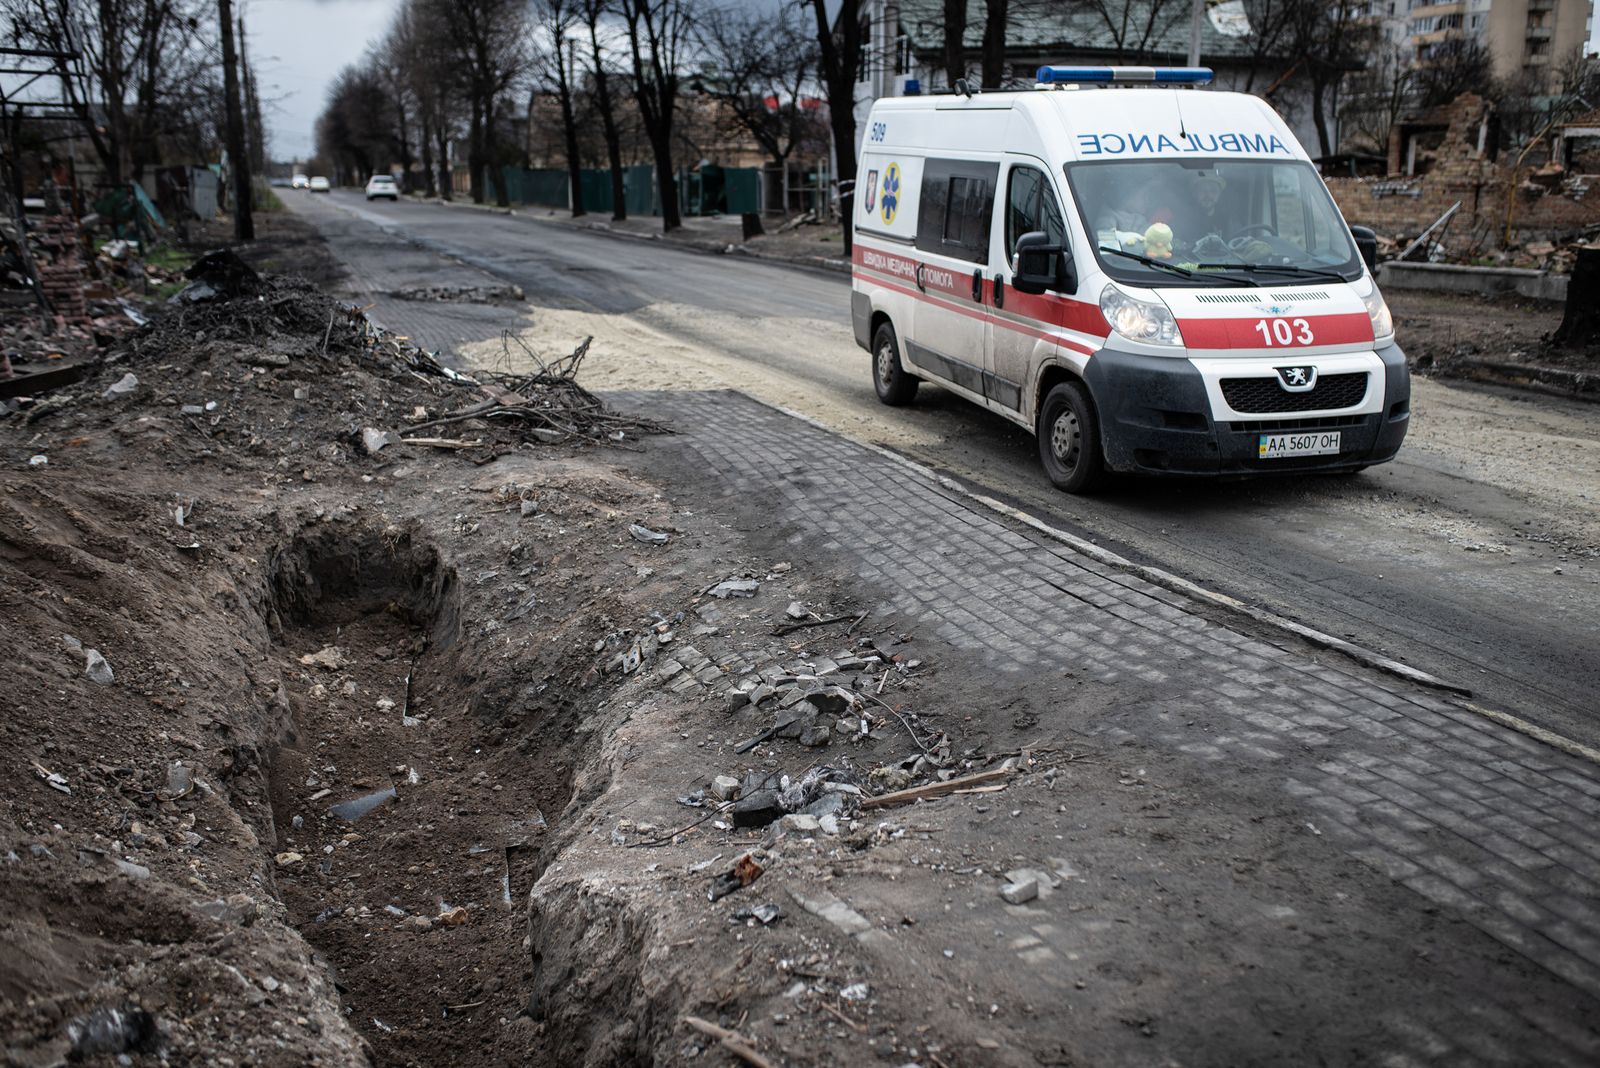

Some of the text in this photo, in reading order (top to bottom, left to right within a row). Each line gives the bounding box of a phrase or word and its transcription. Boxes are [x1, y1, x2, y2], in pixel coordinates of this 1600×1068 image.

[871, 122, 886, 142] 509
[1255, 318, 1315, 346] 103
[1268, 433, 1340, 451] AA 5607 OH
